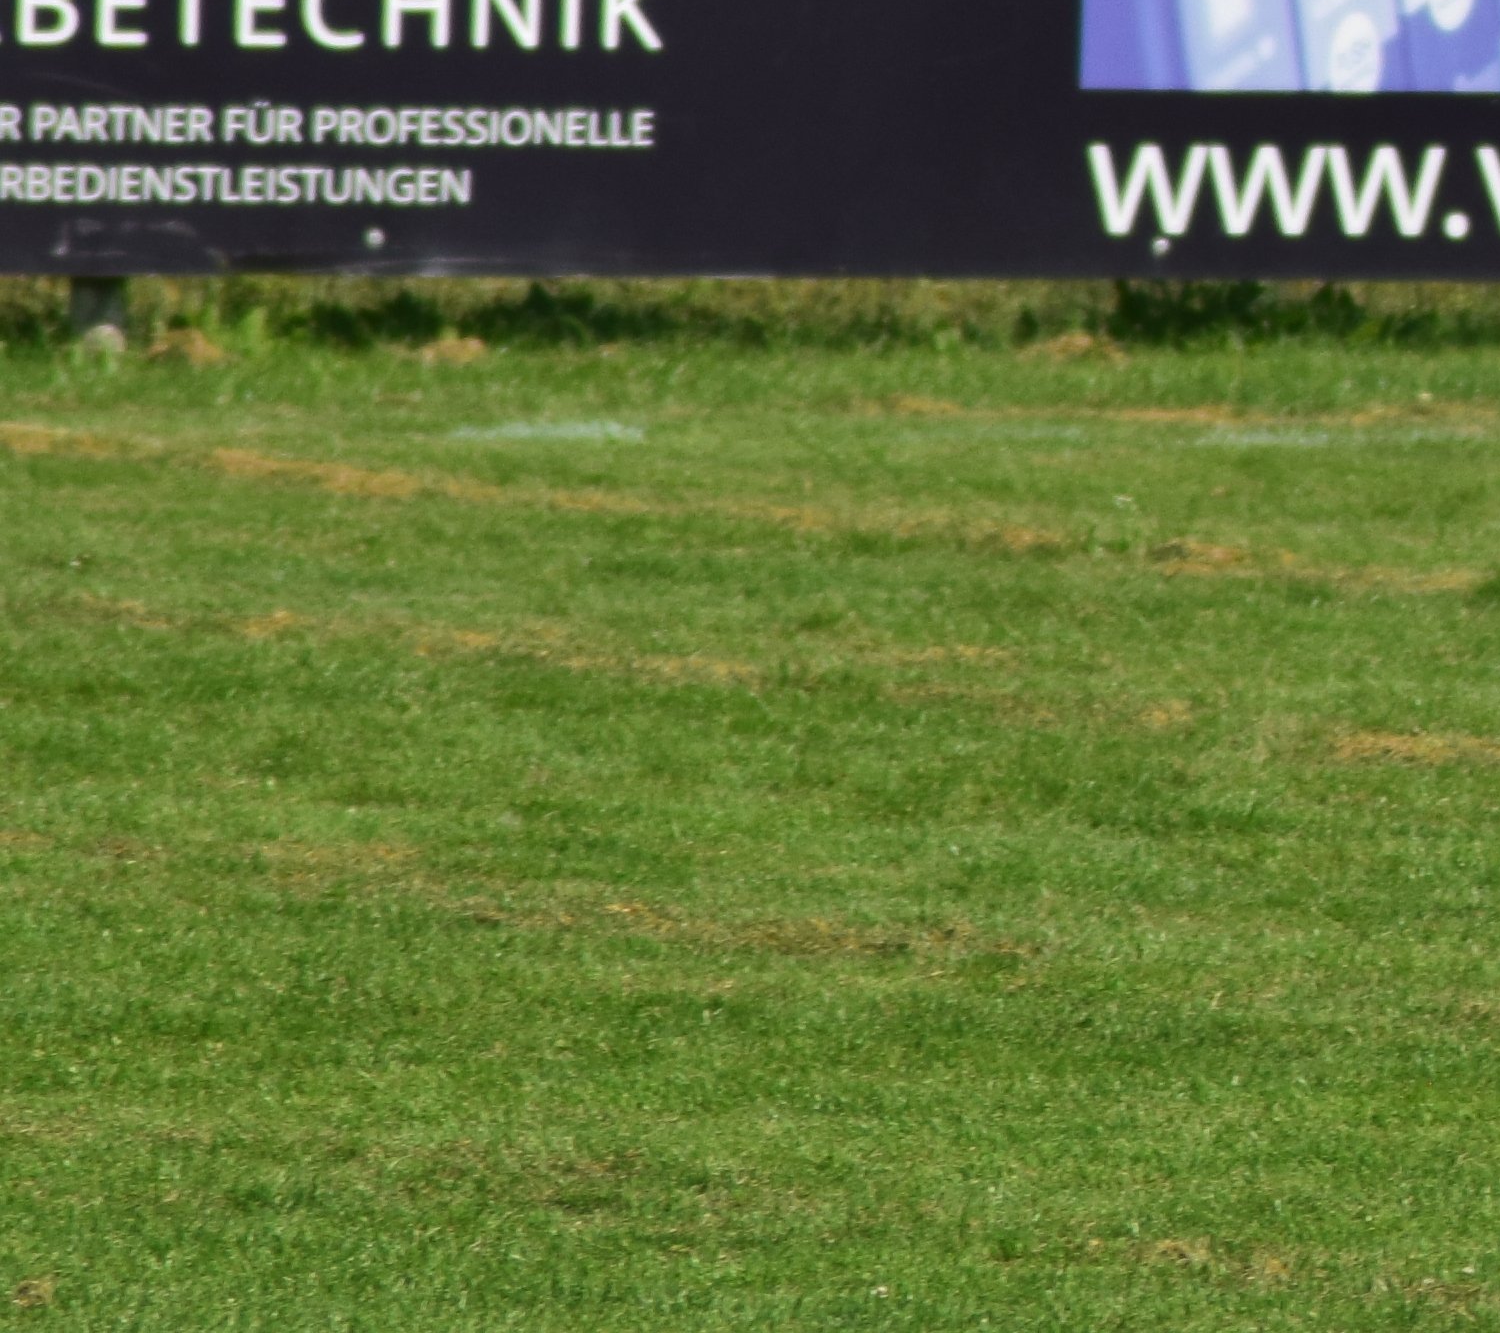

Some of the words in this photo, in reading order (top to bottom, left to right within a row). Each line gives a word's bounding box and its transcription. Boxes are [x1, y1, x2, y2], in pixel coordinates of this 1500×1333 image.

[29, 103, 215, 144] PARTNER
[221, 98, 303, 144] FÜR
[311, 106, 657, 146] PROFESSIONELLE
